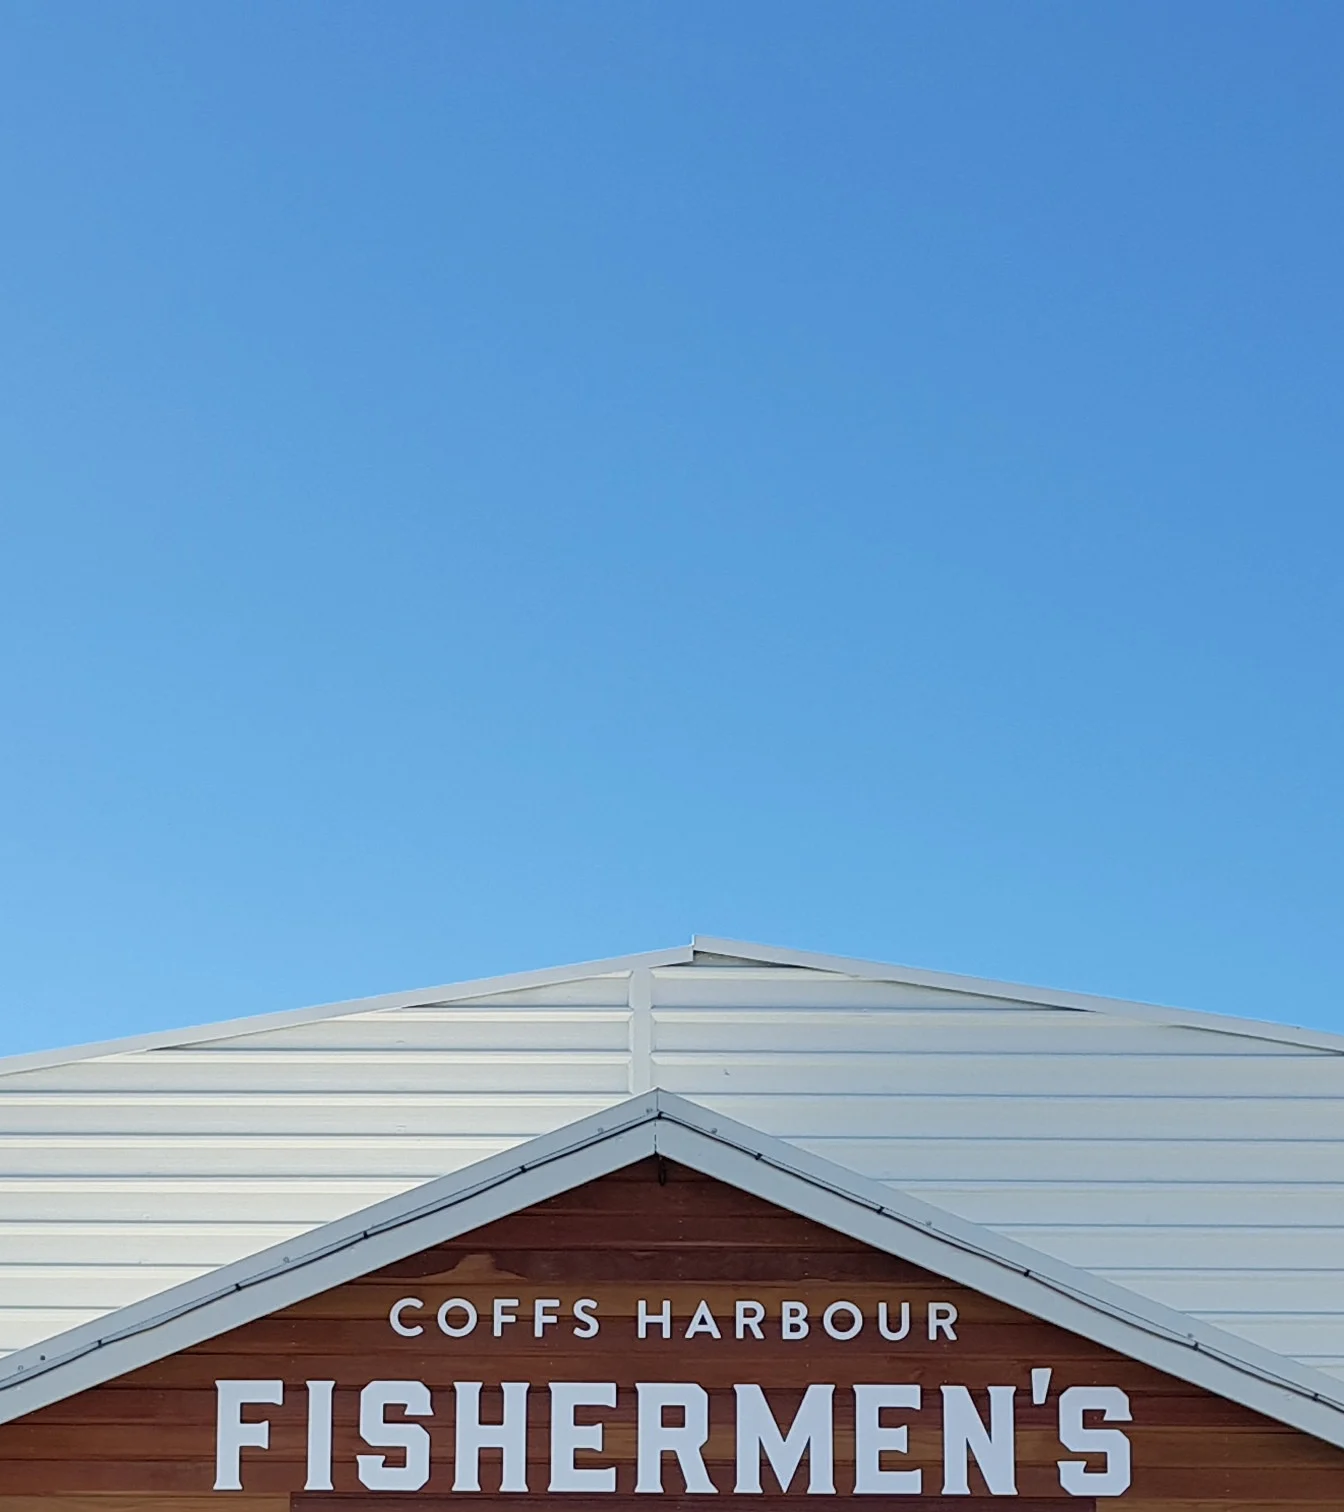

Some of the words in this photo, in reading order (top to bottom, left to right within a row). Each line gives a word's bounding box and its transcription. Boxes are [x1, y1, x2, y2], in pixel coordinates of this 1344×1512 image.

[389, 1296, 601, 1339] COFFS
[636, 1299, 960, 1342] HARBOUR
[212, 1367, 1132, 1497] FISHERMEN'S
